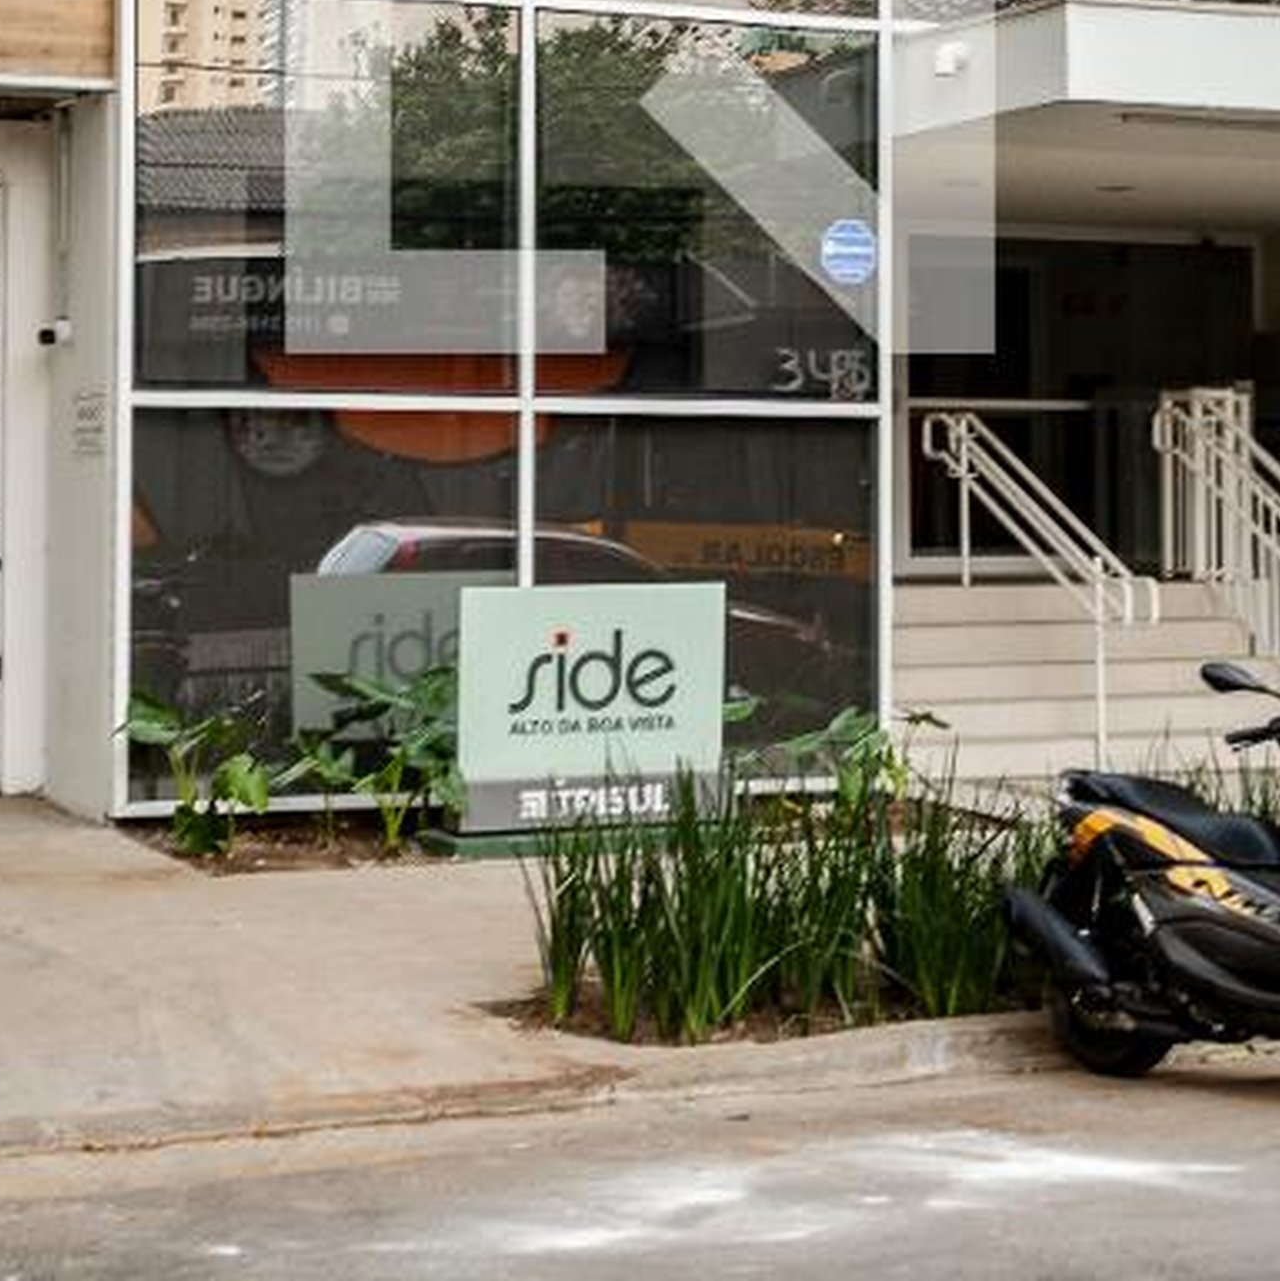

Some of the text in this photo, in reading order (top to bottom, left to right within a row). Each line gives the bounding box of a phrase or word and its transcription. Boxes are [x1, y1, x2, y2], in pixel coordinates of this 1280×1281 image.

[507, 628, 676, 714] side
[508, 713, 676, 736] ALTO DA BOA VISTA
[551, 783, 670, 818] TRISUL
